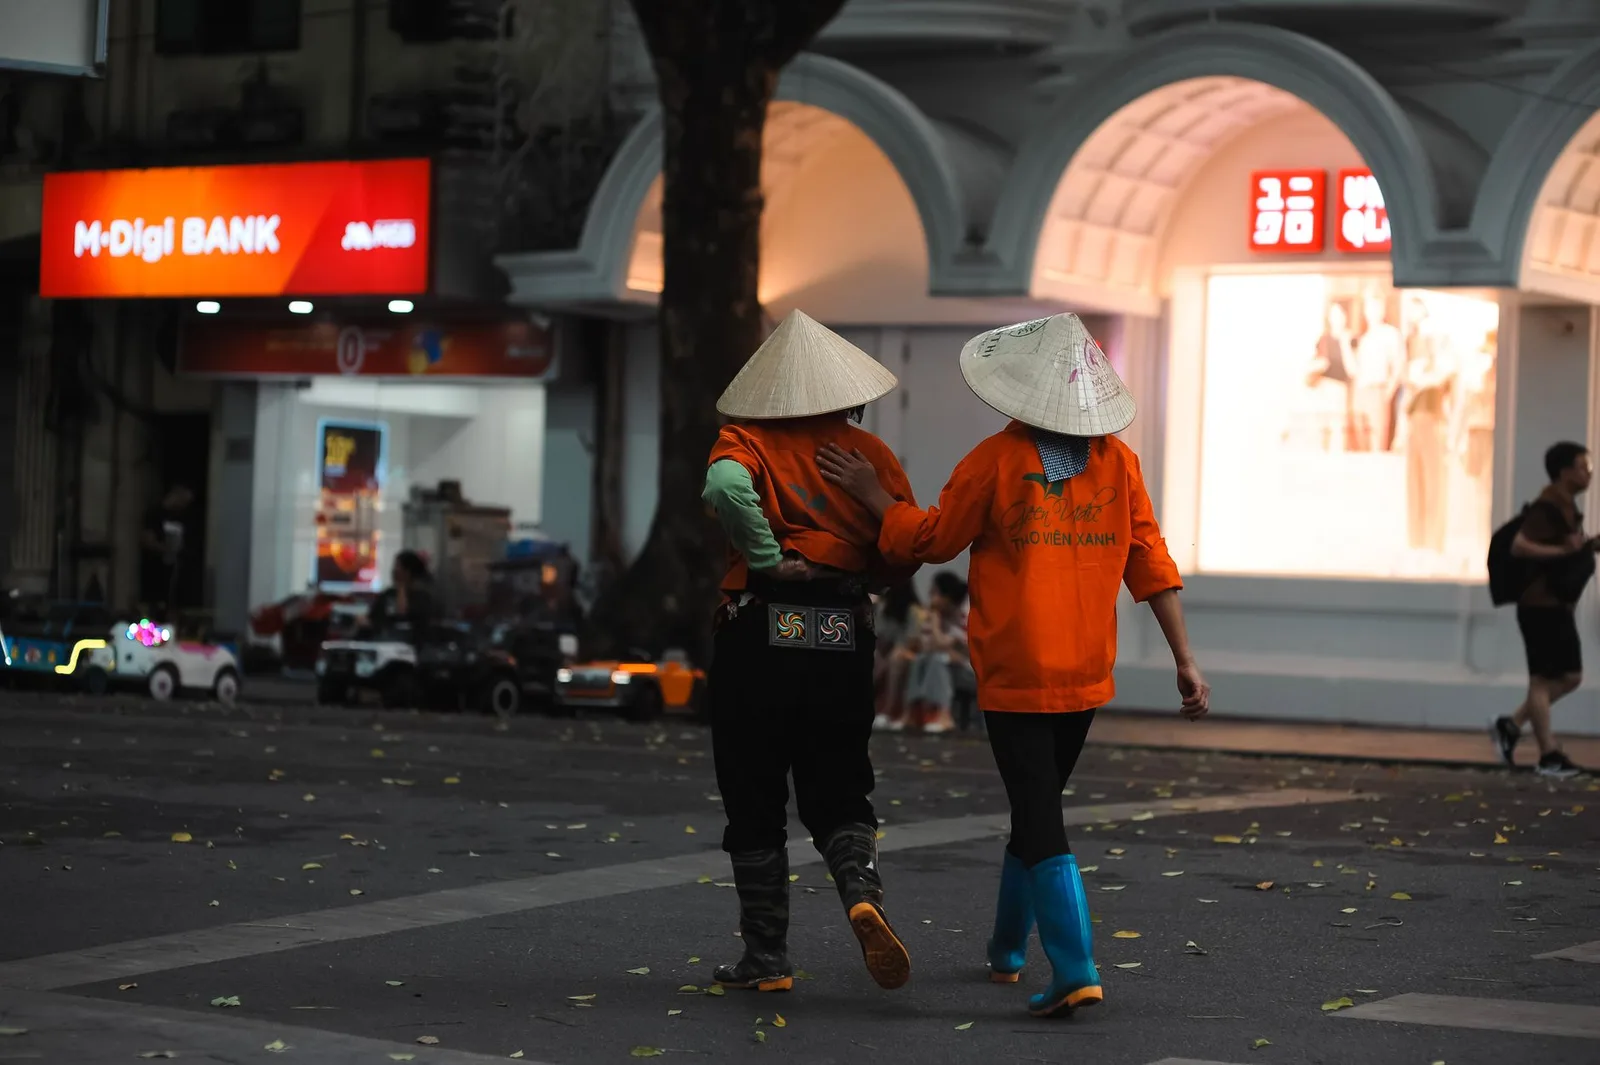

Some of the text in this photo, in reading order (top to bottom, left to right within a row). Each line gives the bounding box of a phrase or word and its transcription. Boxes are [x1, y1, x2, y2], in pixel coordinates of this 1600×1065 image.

[1343, 175, 1387, 209] UN
[182, 214, 281, 255] BANK
[1342, 209, 1392, 248] QL
[1043, 529, 1072, 546] VIÊN
[1076, 532, 1116, 547] XANH
